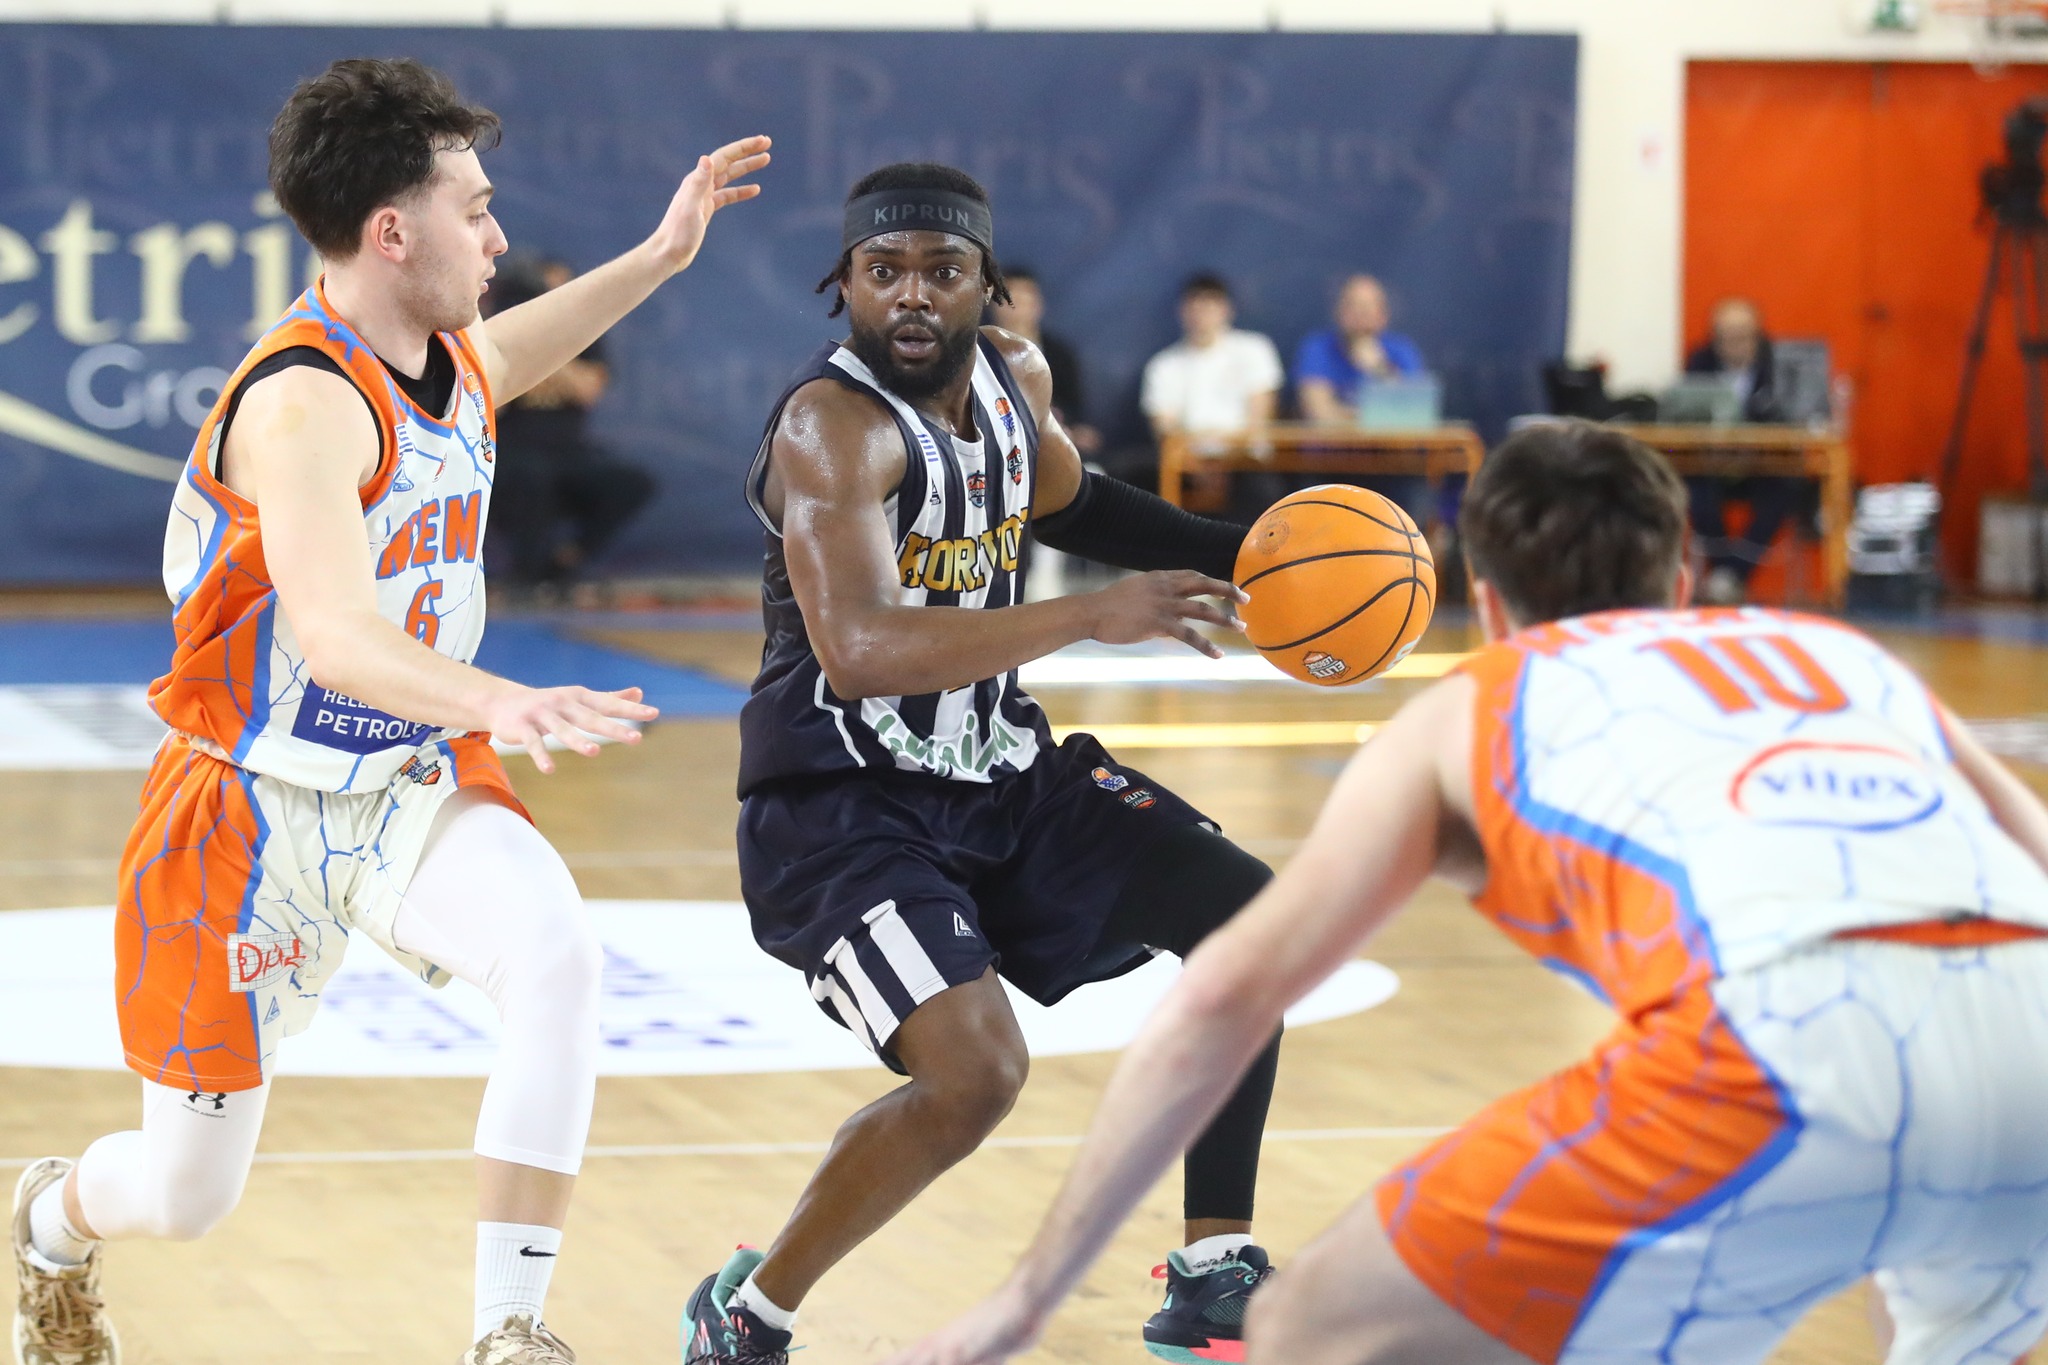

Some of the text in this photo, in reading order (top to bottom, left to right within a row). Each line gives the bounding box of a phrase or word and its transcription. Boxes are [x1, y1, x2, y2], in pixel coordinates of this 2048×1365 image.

[874, 204, 969, 228] KIPRUN
[404, 579, 443, 650] 6
[1634, 633, 1853, 715] 10
